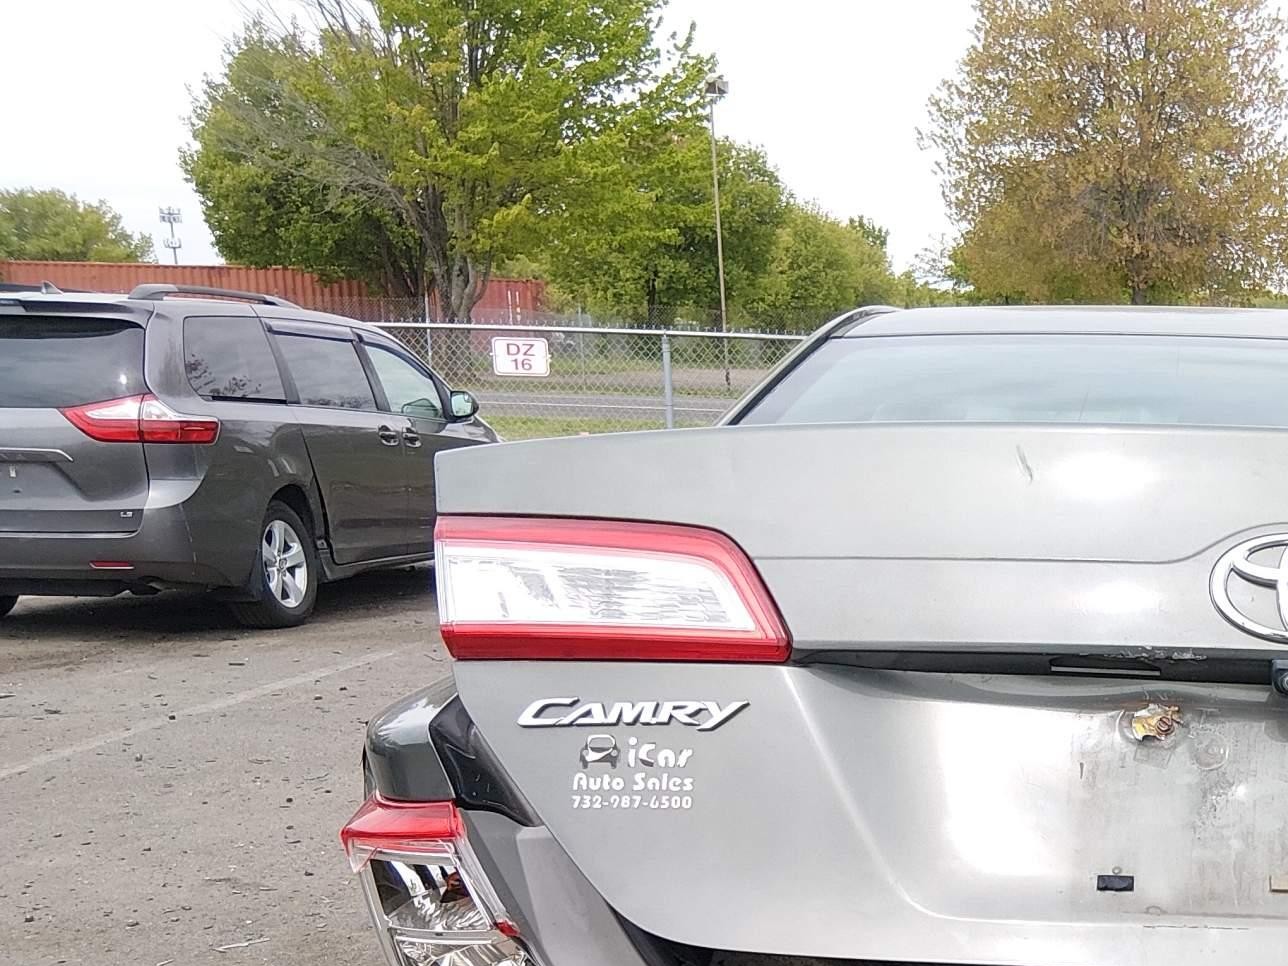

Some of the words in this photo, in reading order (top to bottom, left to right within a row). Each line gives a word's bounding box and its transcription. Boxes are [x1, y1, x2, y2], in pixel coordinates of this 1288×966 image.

[506, 343, 536, 356] DZ
[511, 358, 533, 371] 16
[517, 697, 750, 732] CAMRY
[627, 736, 693, 768] iCar
[572, 772, 625, 791] Auto
[632, 772, 695, 791] Sales
